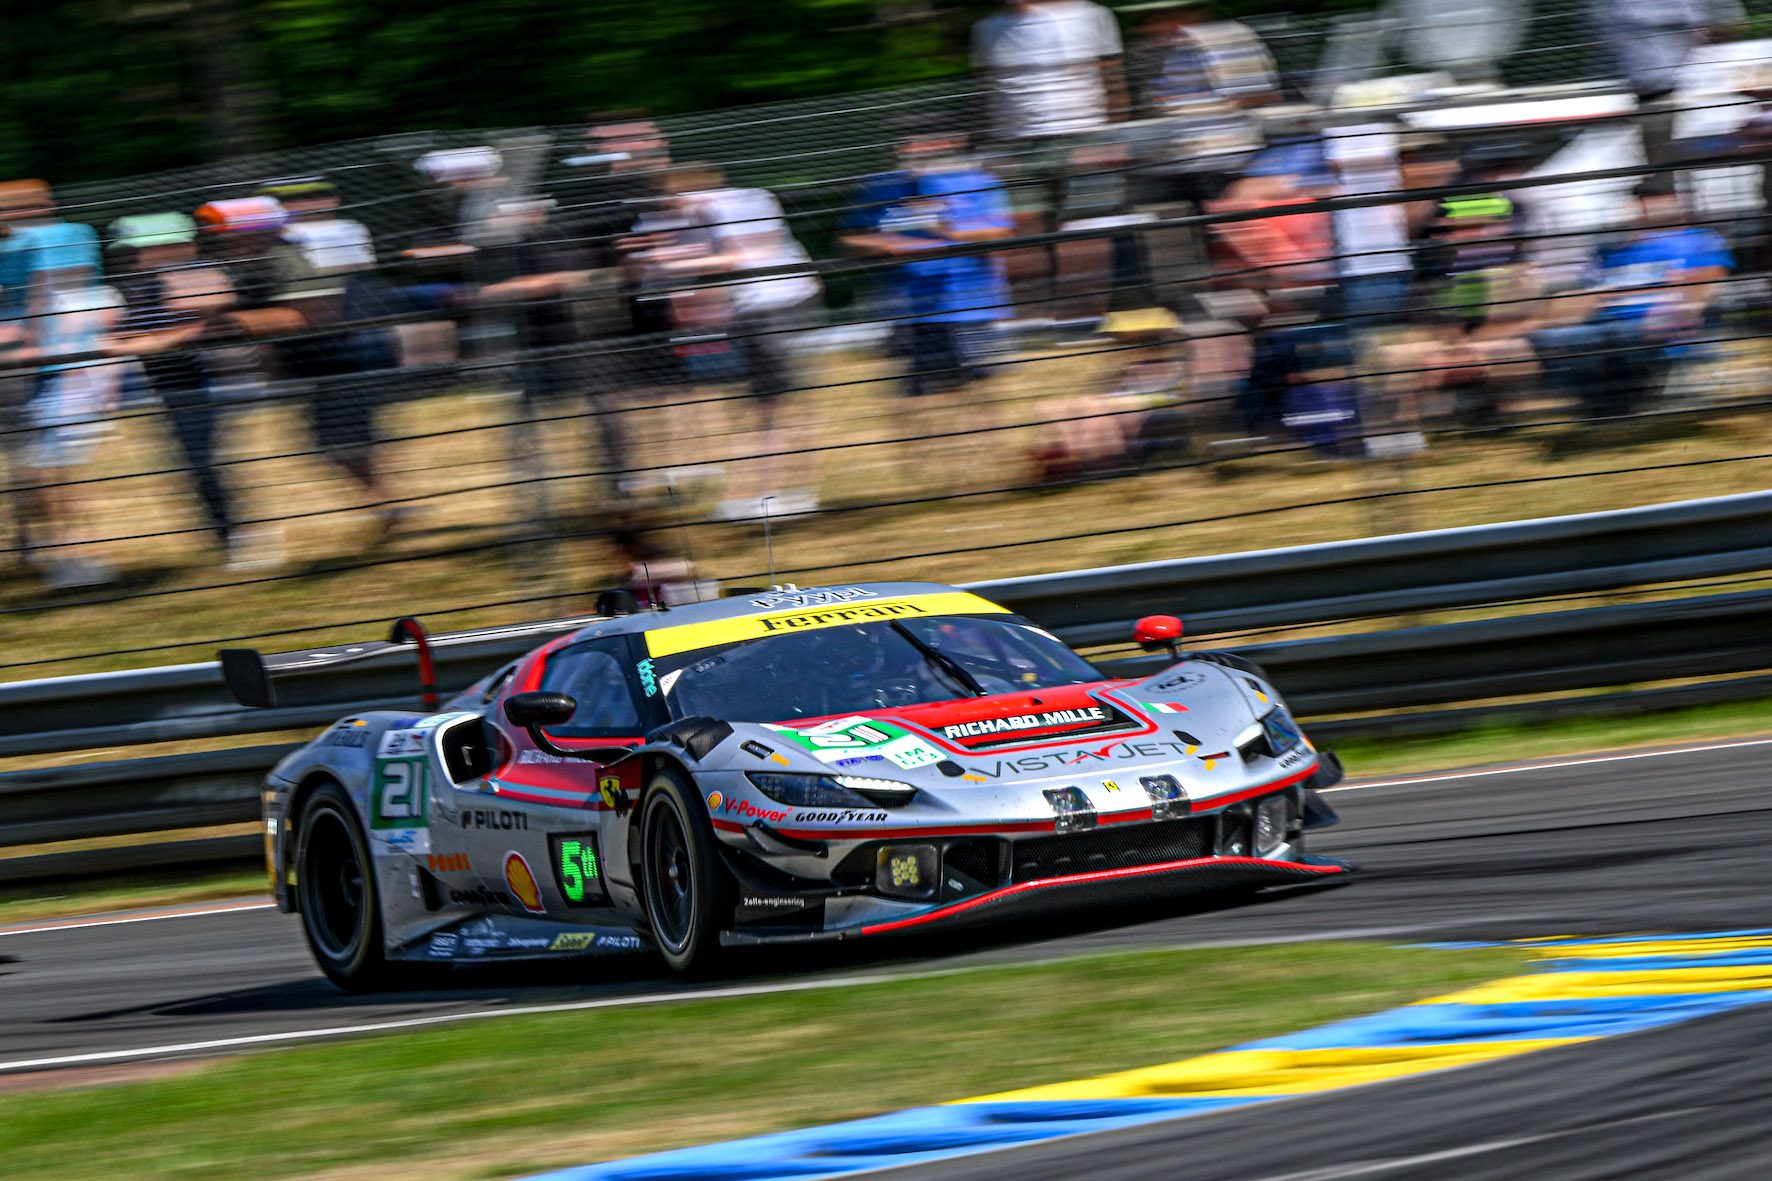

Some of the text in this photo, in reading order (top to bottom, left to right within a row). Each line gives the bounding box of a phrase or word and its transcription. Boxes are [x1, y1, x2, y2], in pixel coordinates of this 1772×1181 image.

[758, 602, 928, 632] Ferrari
[944, 707, 1106, 739] RICHARD MILLE
[380, 761, 423, 818] 21
[475, 810, 528, 831] PILOTI
[725, 797, 787, 823] V-Power
[795, 809, 888, 824] GOODYEAR
